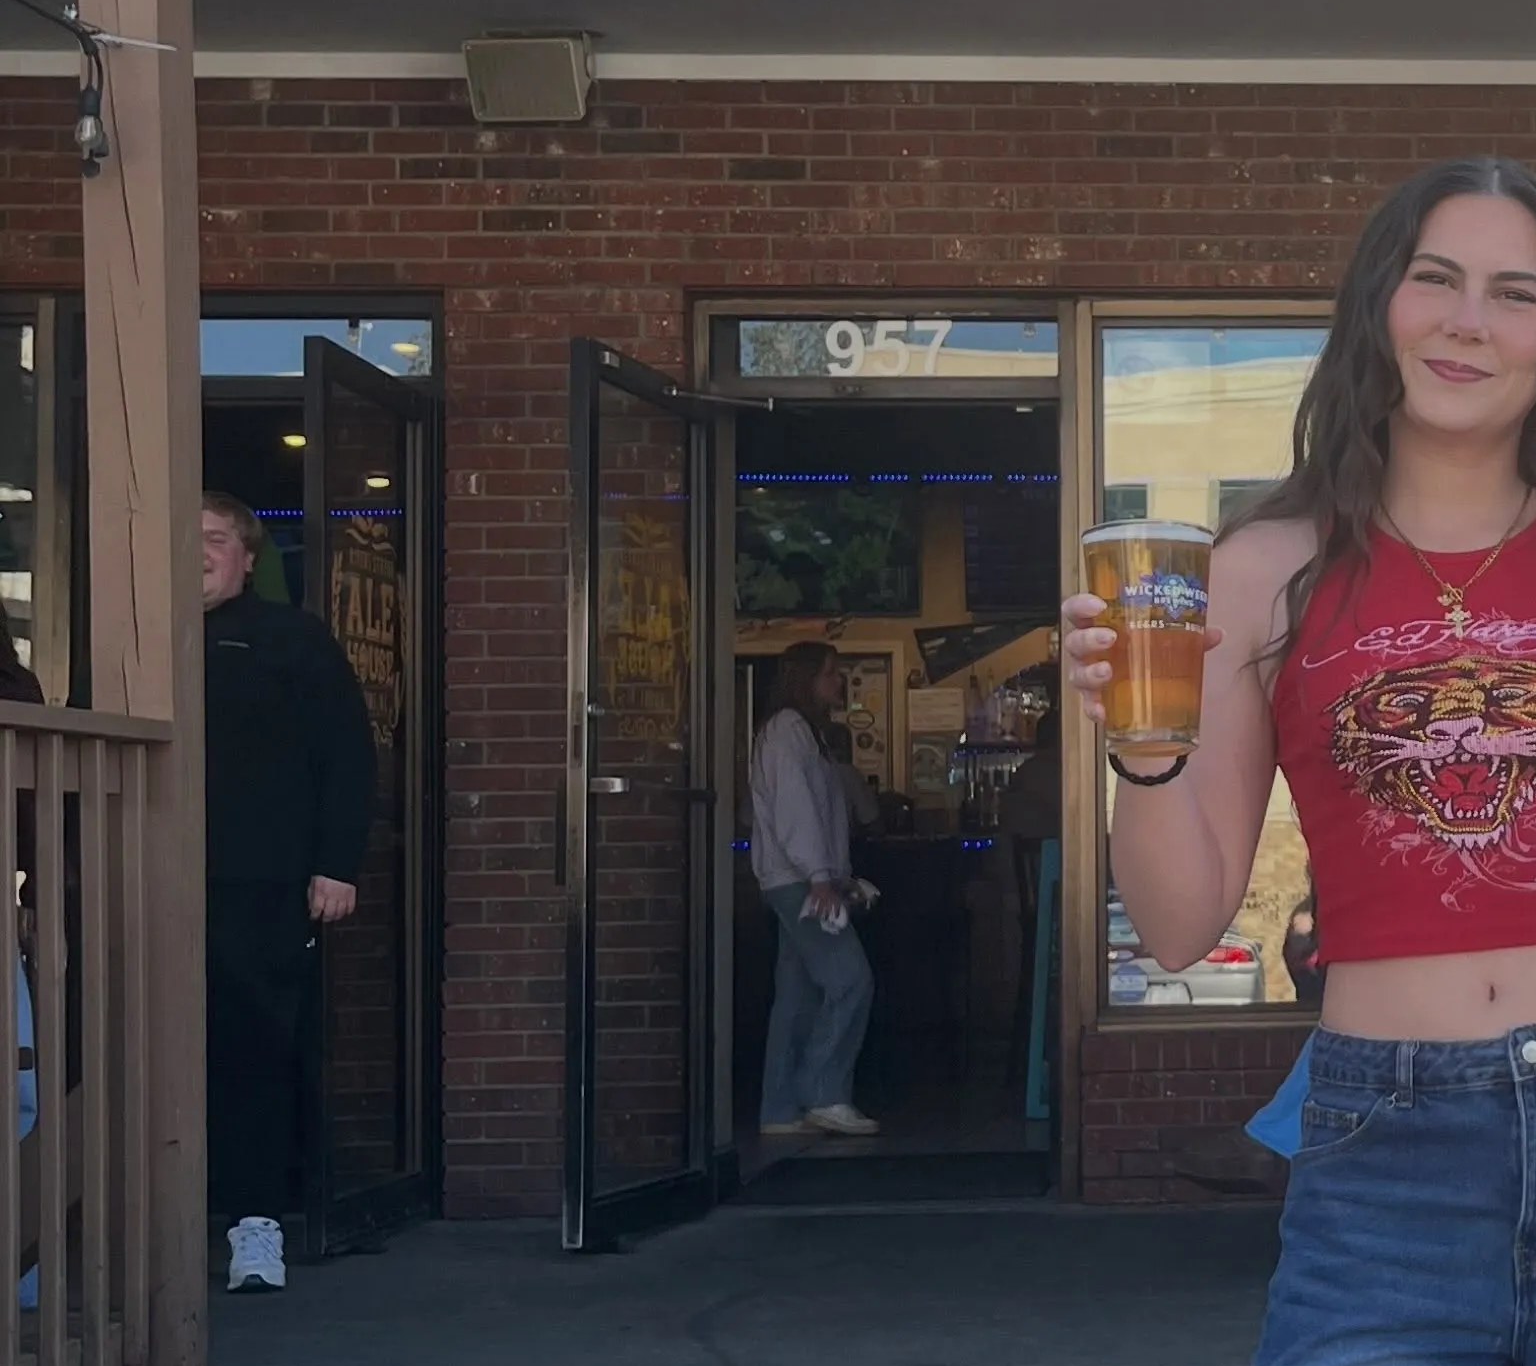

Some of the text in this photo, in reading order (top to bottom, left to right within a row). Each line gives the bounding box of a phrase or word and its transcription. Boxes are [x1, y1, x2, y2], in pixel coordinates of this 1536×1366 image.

[826, 319, 952, 376] 957
[346, 575, 394, 646] ALE
[1125, 585, 1181, 597] WICKED
[1354, 623, 1431, 651] Ed
